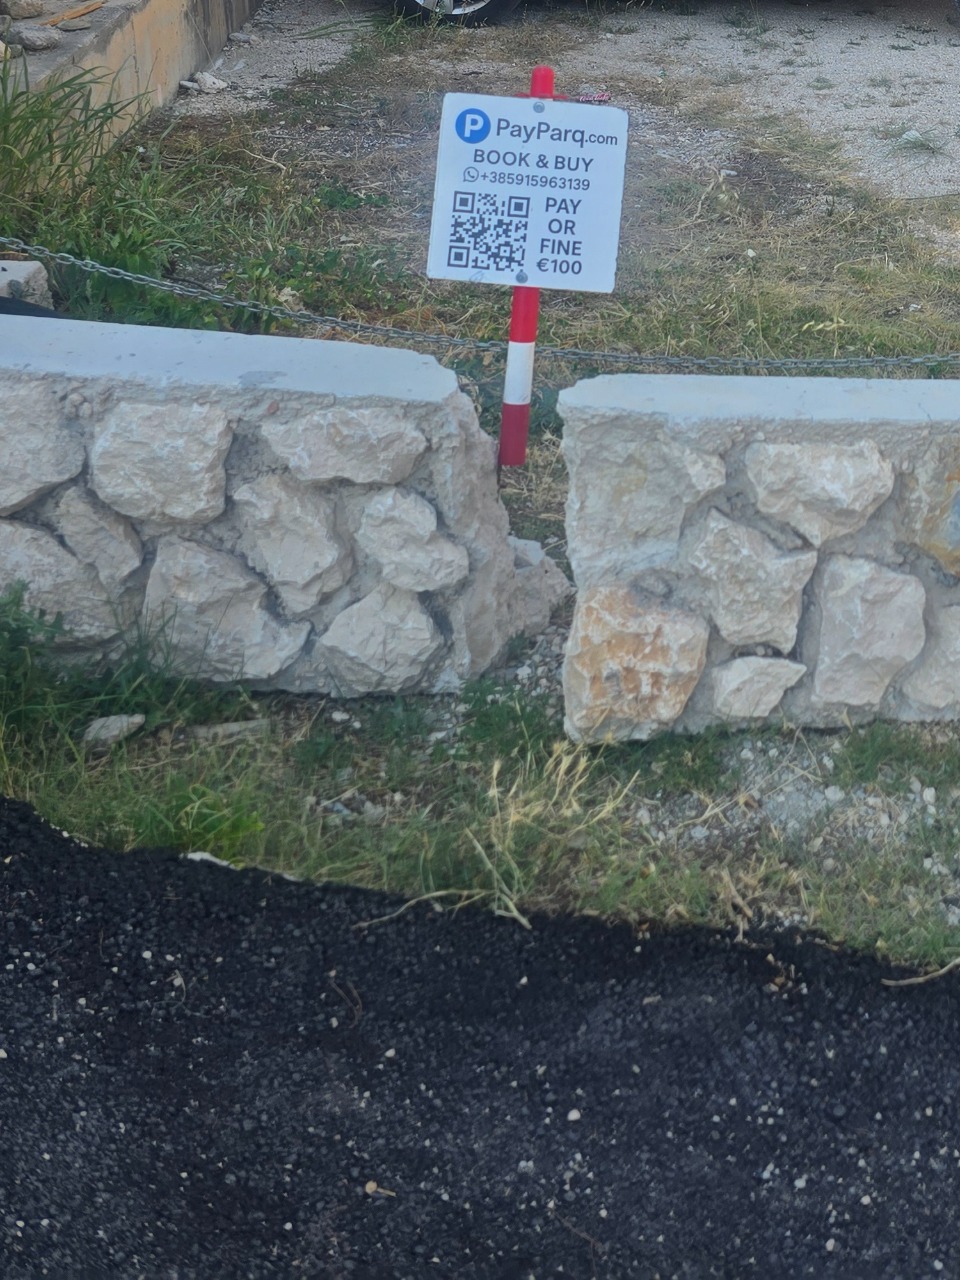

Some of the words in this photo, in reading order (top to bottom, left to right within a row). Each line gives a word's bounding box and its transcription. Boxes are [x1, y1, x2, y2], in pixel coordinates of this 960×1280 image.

[496, 118, 618, 148] PayParq.com
[473, 148, 530, 167] BOOK
[535, 153, 550, 169] &
[554, 155, 594, 172] BUY
[481, 171, 591, 191] +385915963139
[545, 197, 582, 215] PAY
[548, 218, 576, 235] OR
[540, 238, 582, 256] FINE
[536, 258, 582, 275] €100
